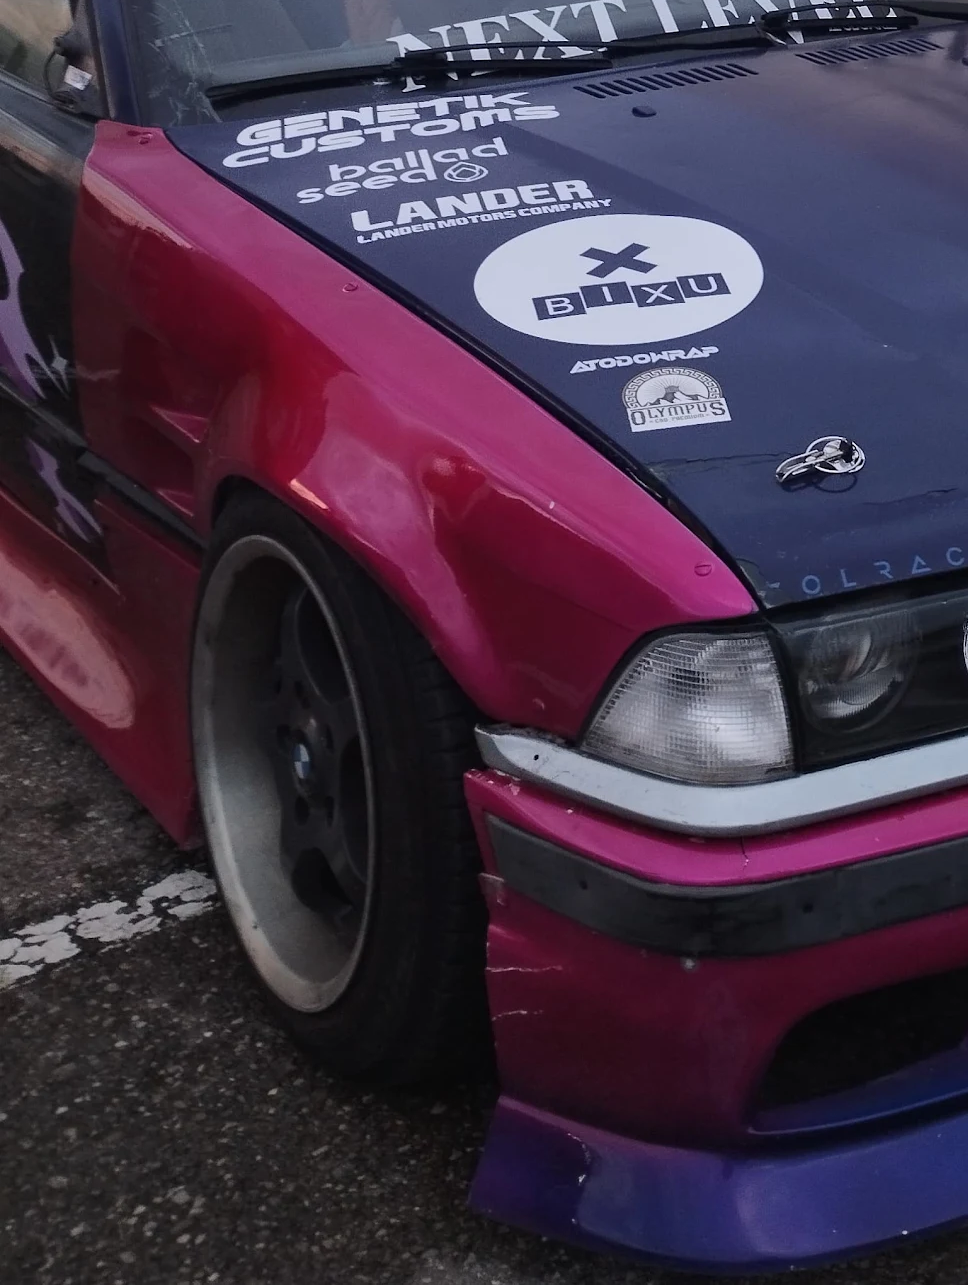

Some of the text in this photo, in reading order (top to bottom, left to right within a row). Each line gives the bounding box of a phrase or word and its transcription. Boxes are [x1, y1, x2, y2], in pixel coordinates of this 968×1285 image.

[236, 92, 532, 147] GENETIK
[328, 136, 509, 183] ballad
[296, 161, 438, 204] seed
[351, 179, 595, 232] LANDER
[356, 198, 612, 244] LANDER MOTORS COMPANY
[547, 274, 719, 317] BIXU
[569, 345, 720, 375] ATODOWRAP
[631, 402, 725, 425] OLYMPUS
